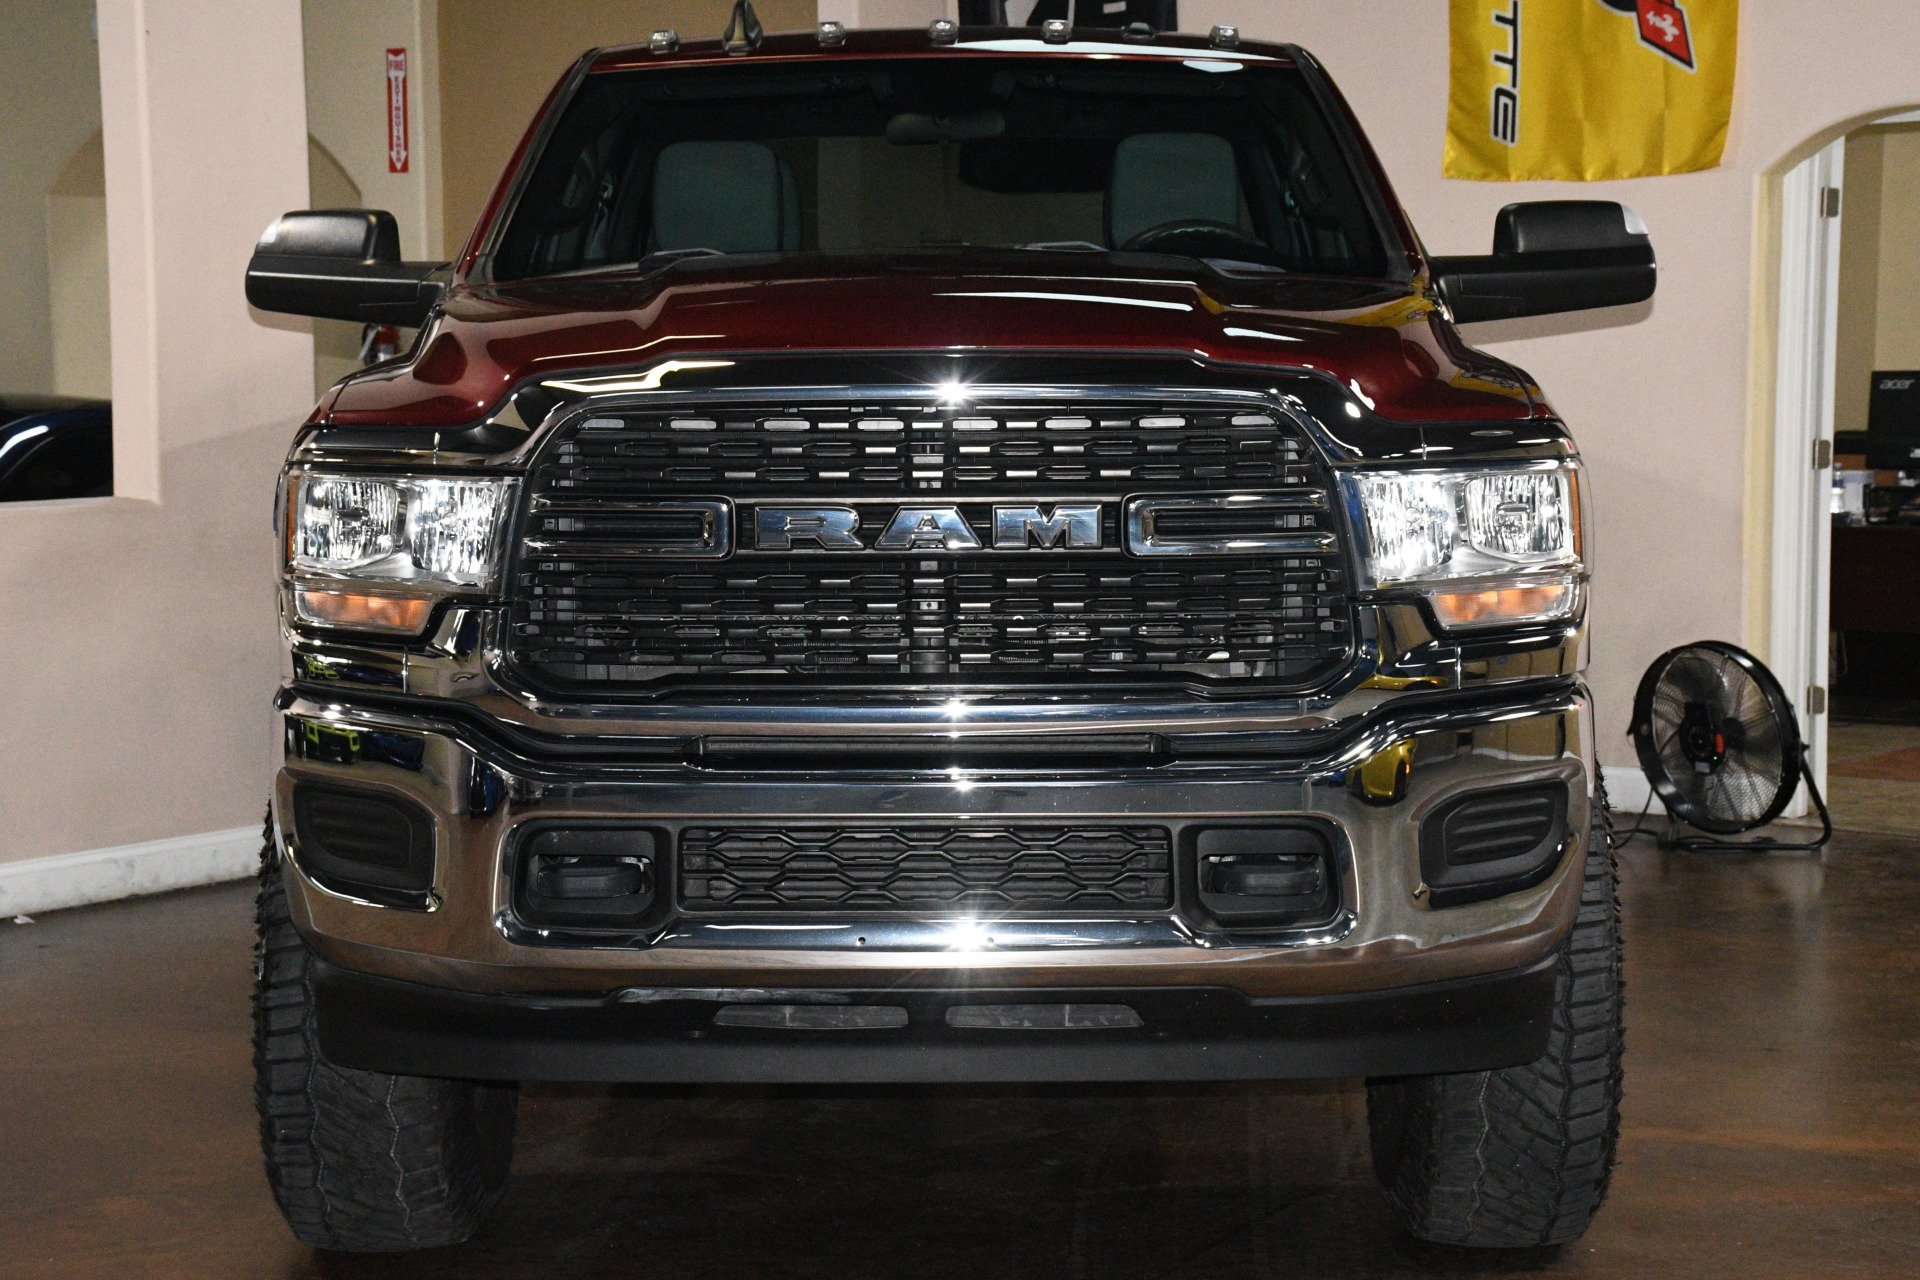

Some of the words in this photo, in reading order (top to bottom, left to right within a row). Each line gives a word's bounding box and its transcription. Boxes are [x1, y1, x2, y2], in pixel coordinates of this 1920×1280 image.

[1492, 0, 1520, 145] TTE
[1879, 378, 1914, 390] acer
[754, 504, 1103, 550] RAM
